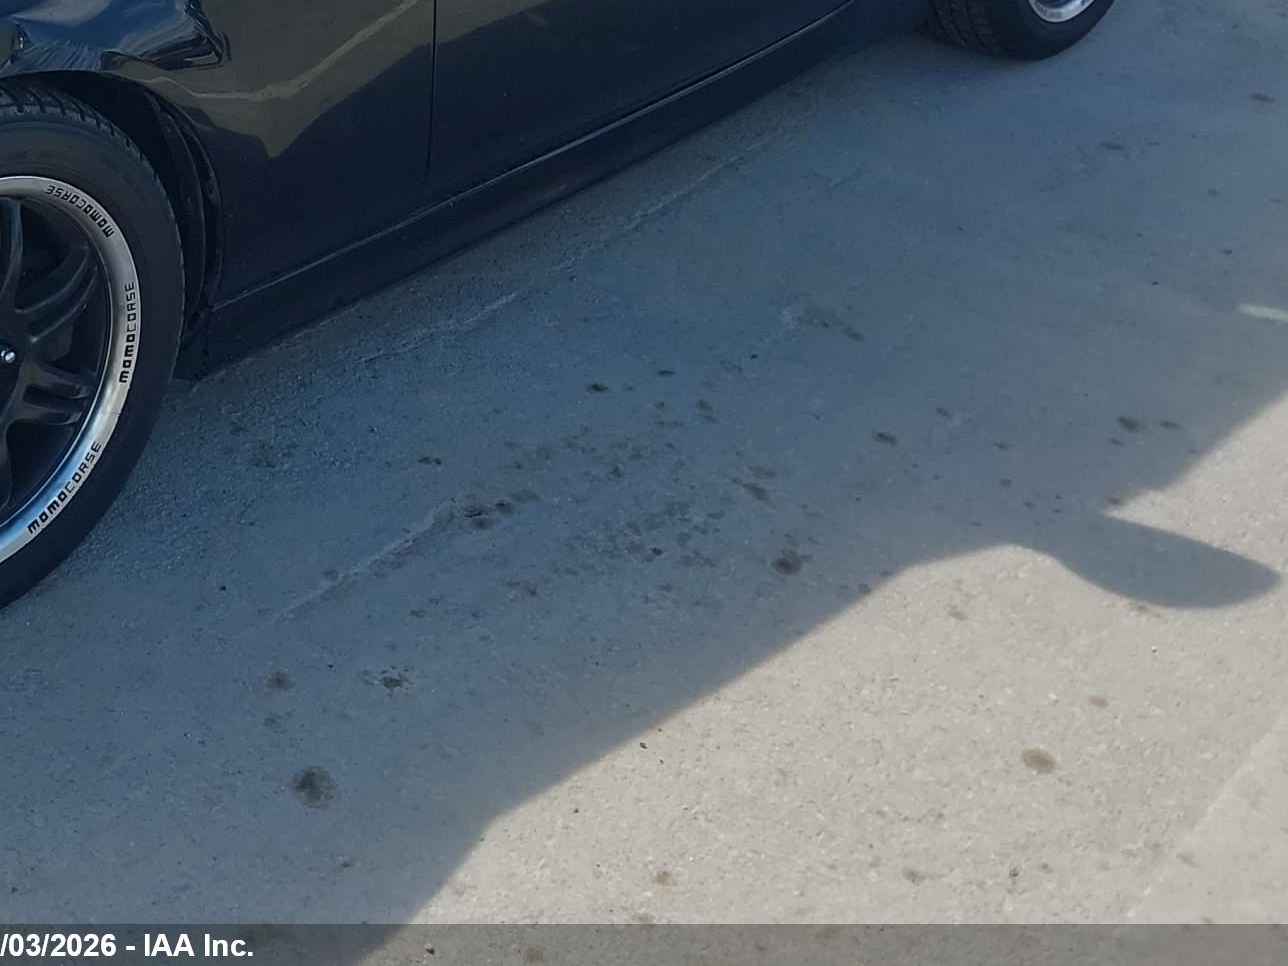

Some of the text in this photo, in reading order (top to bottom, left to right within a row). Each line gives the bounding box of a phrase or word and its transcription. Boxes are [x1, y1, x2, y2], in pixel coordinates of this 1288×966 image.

[45, 185, 115, 238] MOMOCORSE
[118, 281, 138, 384] MOMOCORSE
[26, 440, 102, 535] MOMOCORSE
